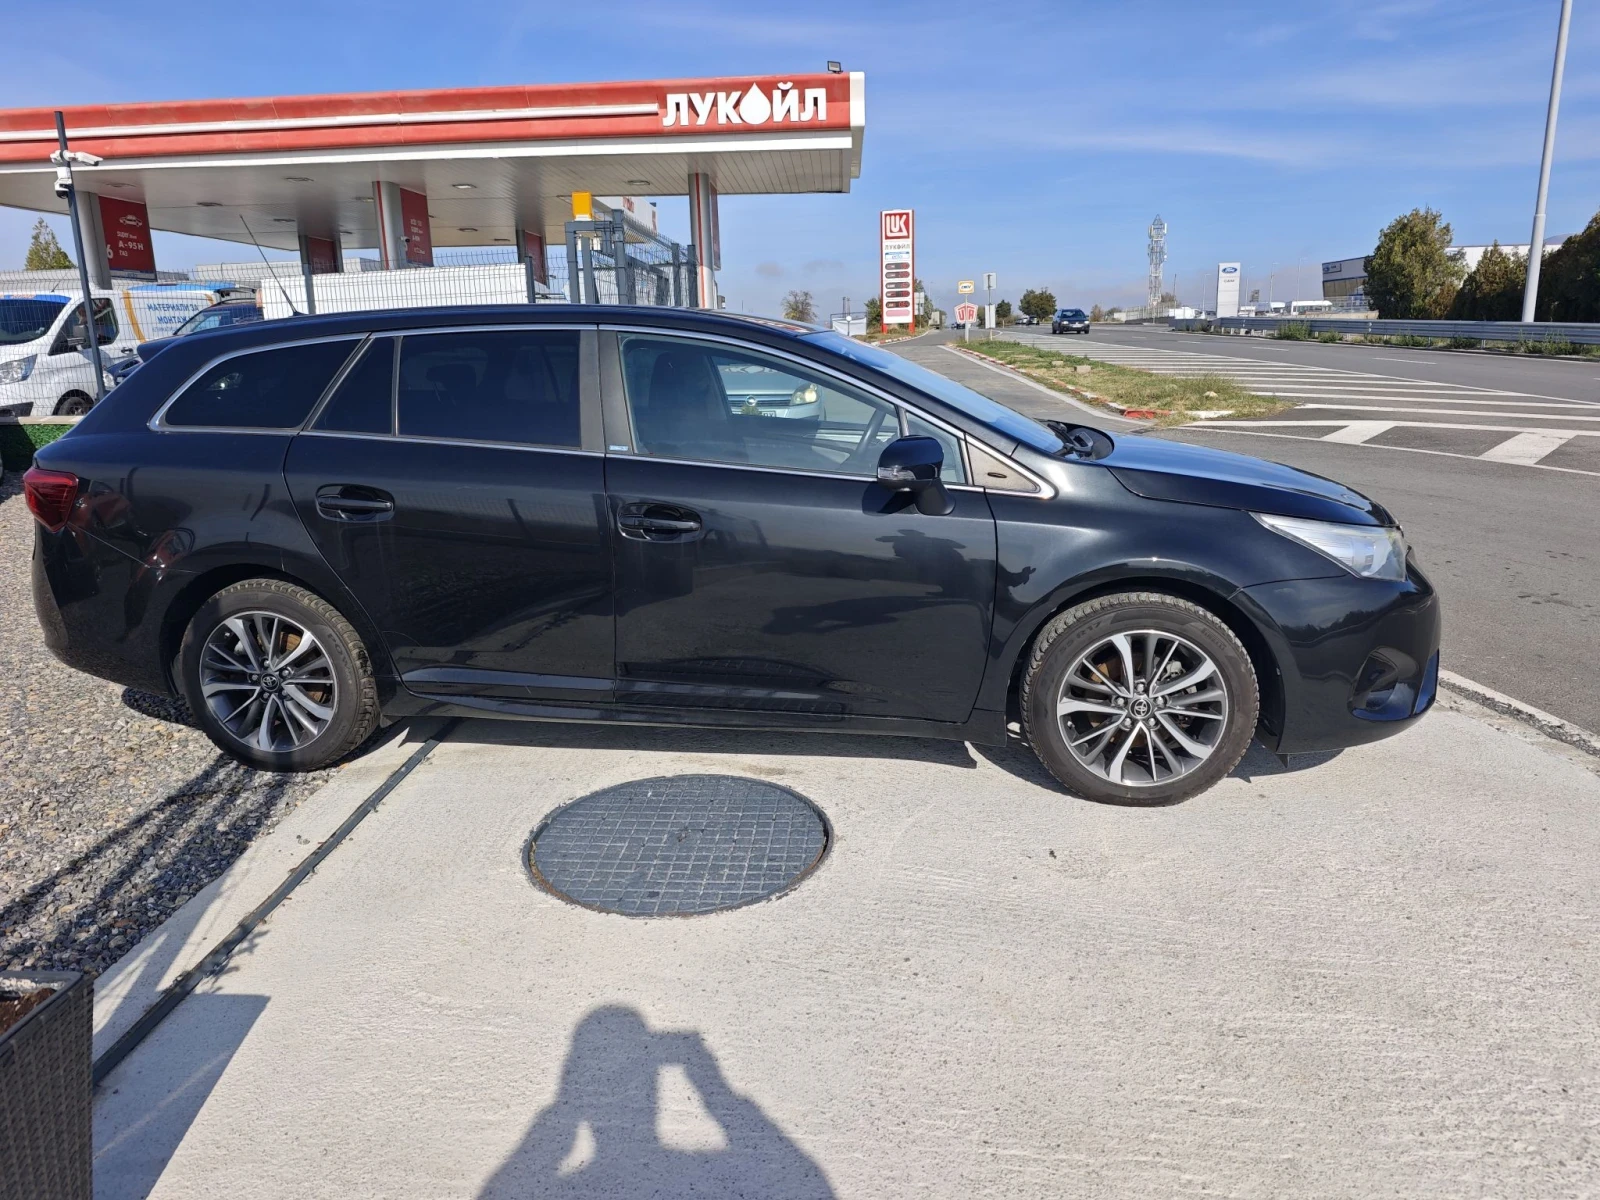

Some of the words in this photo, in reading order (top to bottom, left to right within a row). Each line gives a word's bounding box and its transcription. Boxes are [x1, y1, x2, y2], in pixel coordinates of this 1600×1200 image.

[662, 81, 827, 127] ЛУКОЙЛ
[886, 214, 908, 237] LUK
[147, 303, 189, 312] МАТЕРИАЛИ
[190, 304, 199, 312] ЗА
